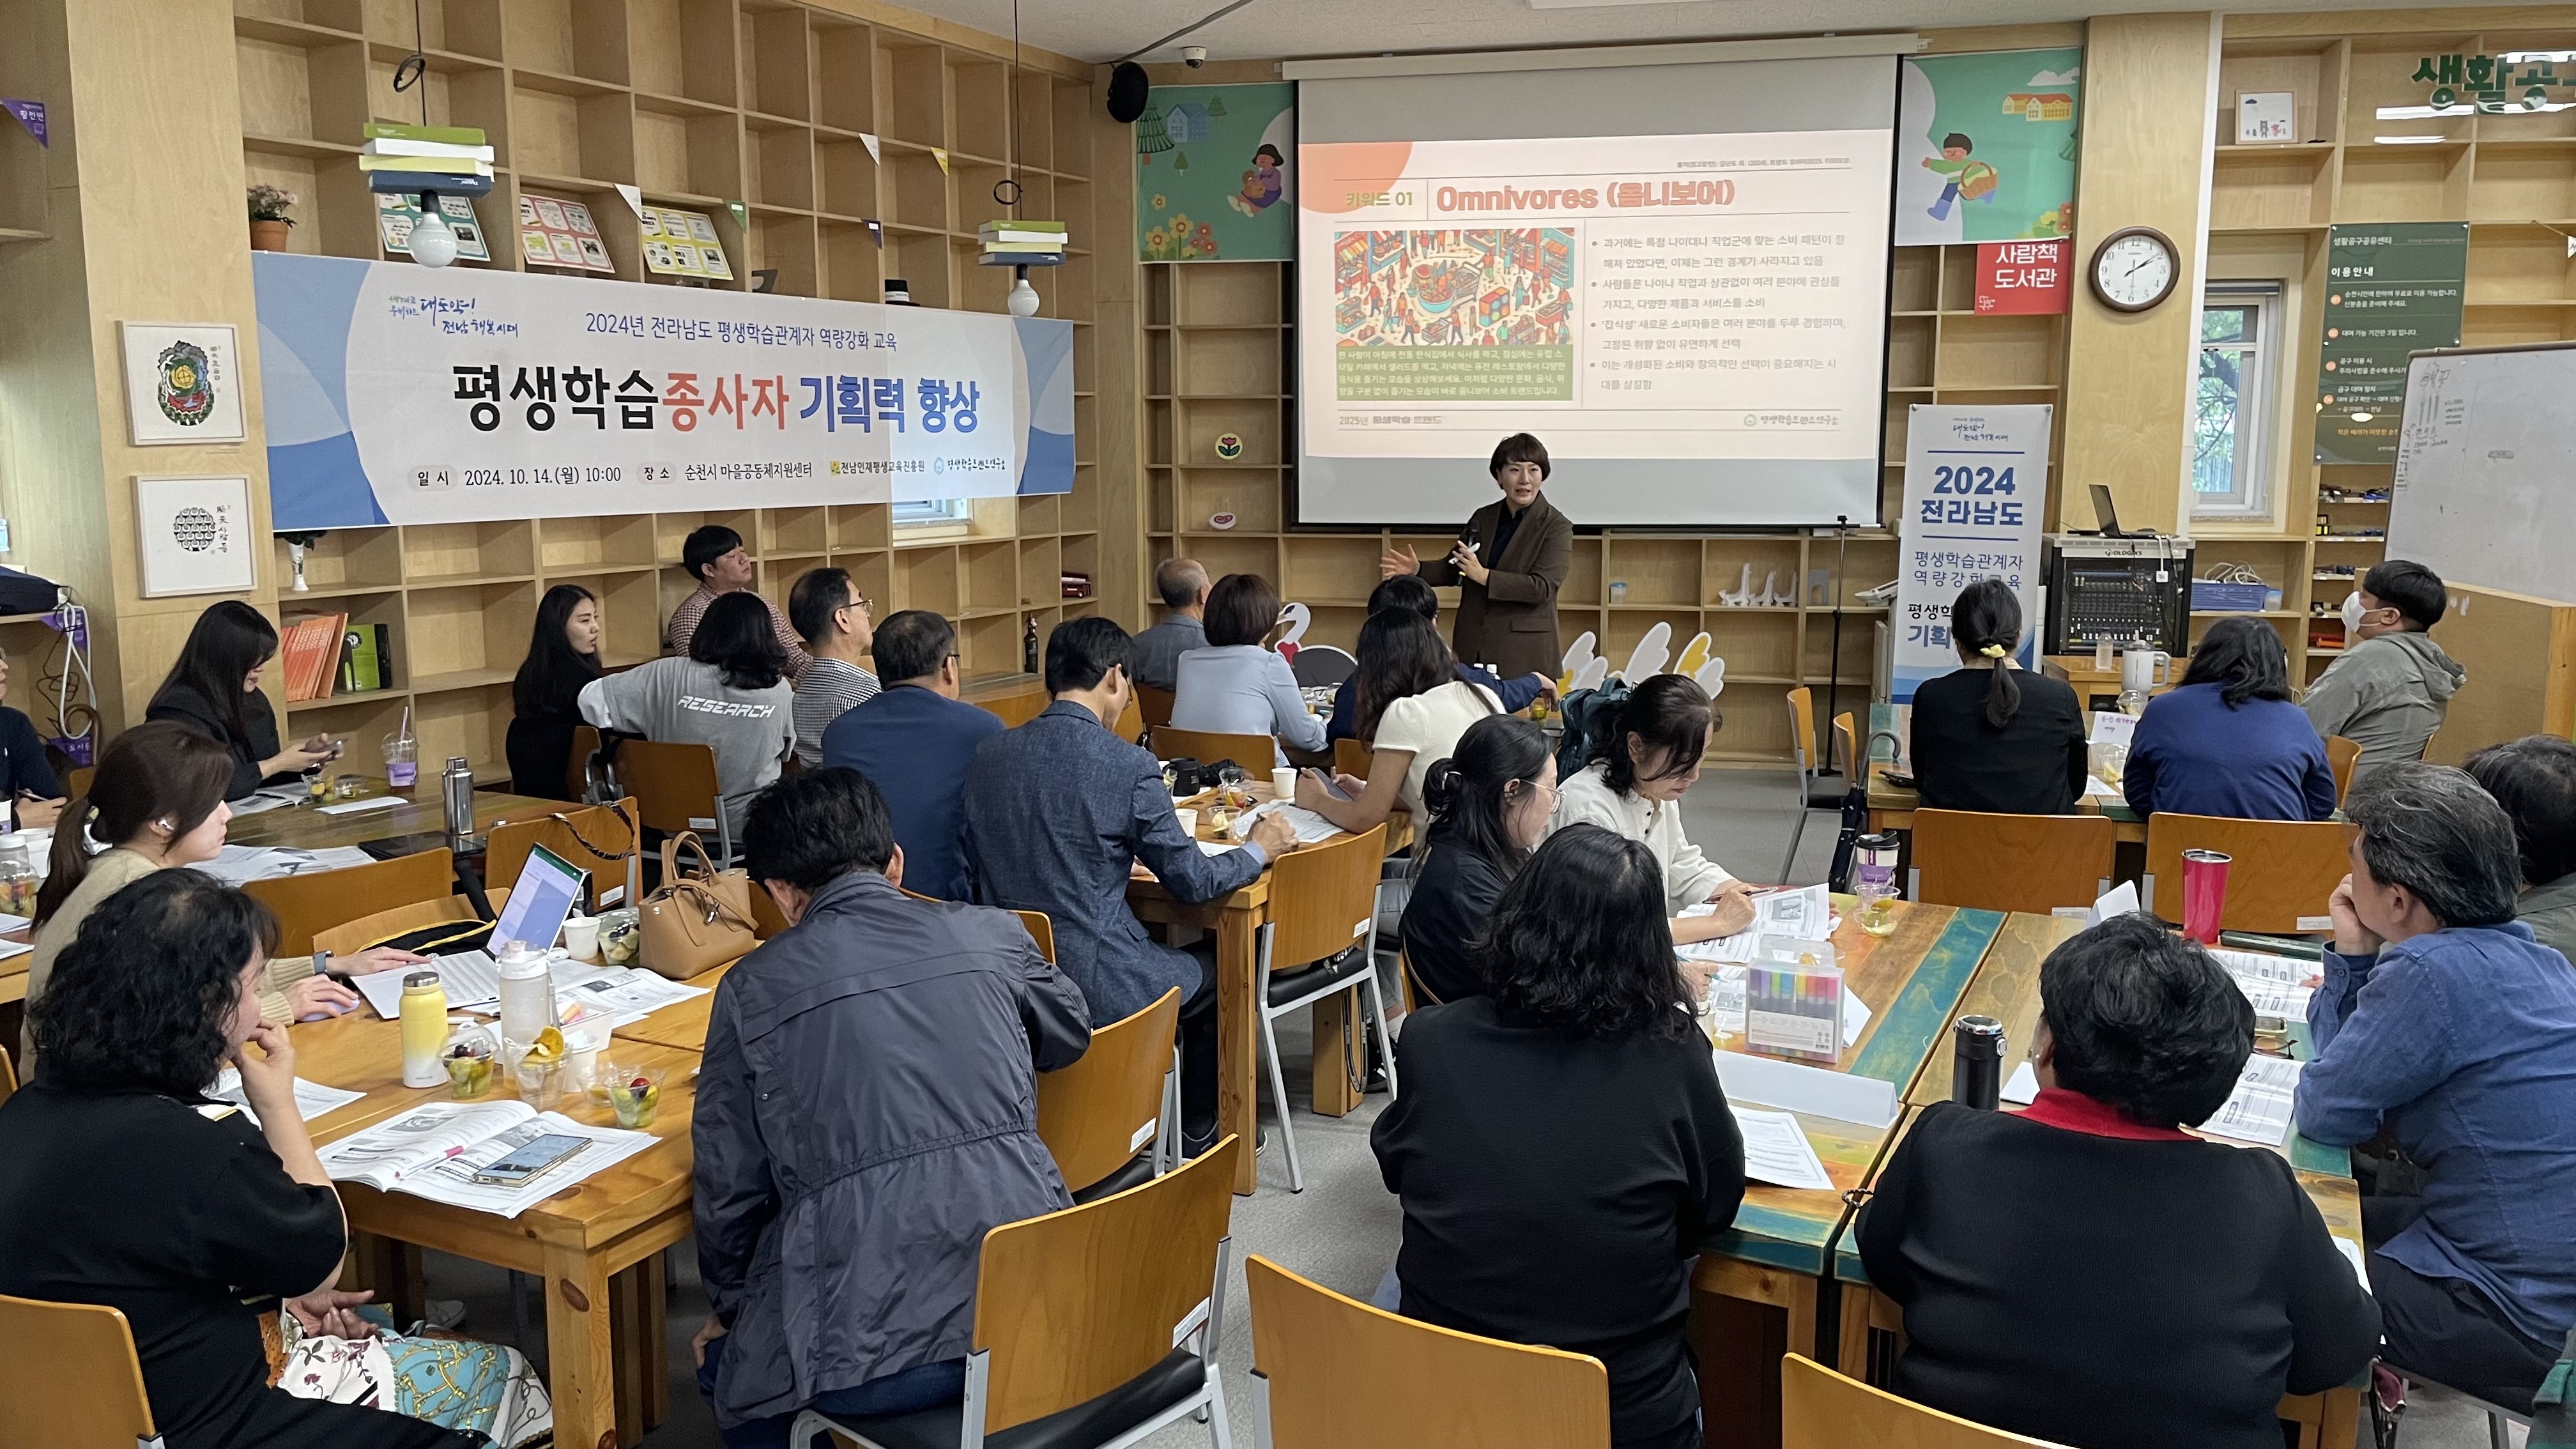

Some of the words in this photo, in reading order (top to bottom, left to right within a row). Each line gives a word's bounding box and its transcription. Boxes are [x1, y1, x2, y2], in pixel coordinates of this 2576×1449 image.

[1346, 190, 1391, 209] 키워드
[1395, 192, 1412, 206] 01
[1436, 183, 1598, 211] Omnivores
[1606, 179, 1735, 208] (옴니보어)
[2118, 241, 2125, 250] 11
[2132, 238, 2141, 247] 12
[2149, 241, 2152, 250] 1
[1996, 244, 2058, 264] 사람책
[2106, 251, 2115, 260] 10
[1994, 268, 2058, 288] 도서관
[2101, 266, 2108, 275] 9
[2159, 266, 2166, 274] 3
[2104, 279, 2110, 288] 8
[2115, 291, 2120, 299] 7
[443, 319, 468, 334] 전남
[586, 313, 645, 337] 2024년
[650, 317, 713, 340] 전라남도
[717, 321, 815, 346] 평생학습관계자
[820, 325, 869, 350] 역량강화
[873, 329, 898, 351] 교육
[800, 374, 905, 433] 기획력
[917, 377, 980, 433] 향상
[1339, 416, 1368, 425] 2025년
[464, 470, 504, 487] 2024.
[510, 468, 529, 485] 10.
[533, 466, 580, 486] 14.(월)
[585, 466, 622, 482] 10:00
[684, 464, 717, 481] 순천시
[721, 463, 813, 481] 마을공동체지원센터
[841, 459, 925, 475] 전남인재평생교육진흥원
[1933, 466, 2016, 495] 2024
[1920, 500, 2024, 526] 전라남도
[1915, 551, 2024, 571] 평생학습관계자
[1908, 603, 1954, 620] 평생학
[1908, 625, 1952, 650] 기획
[677, 694, 776, 719] RESEARCH
